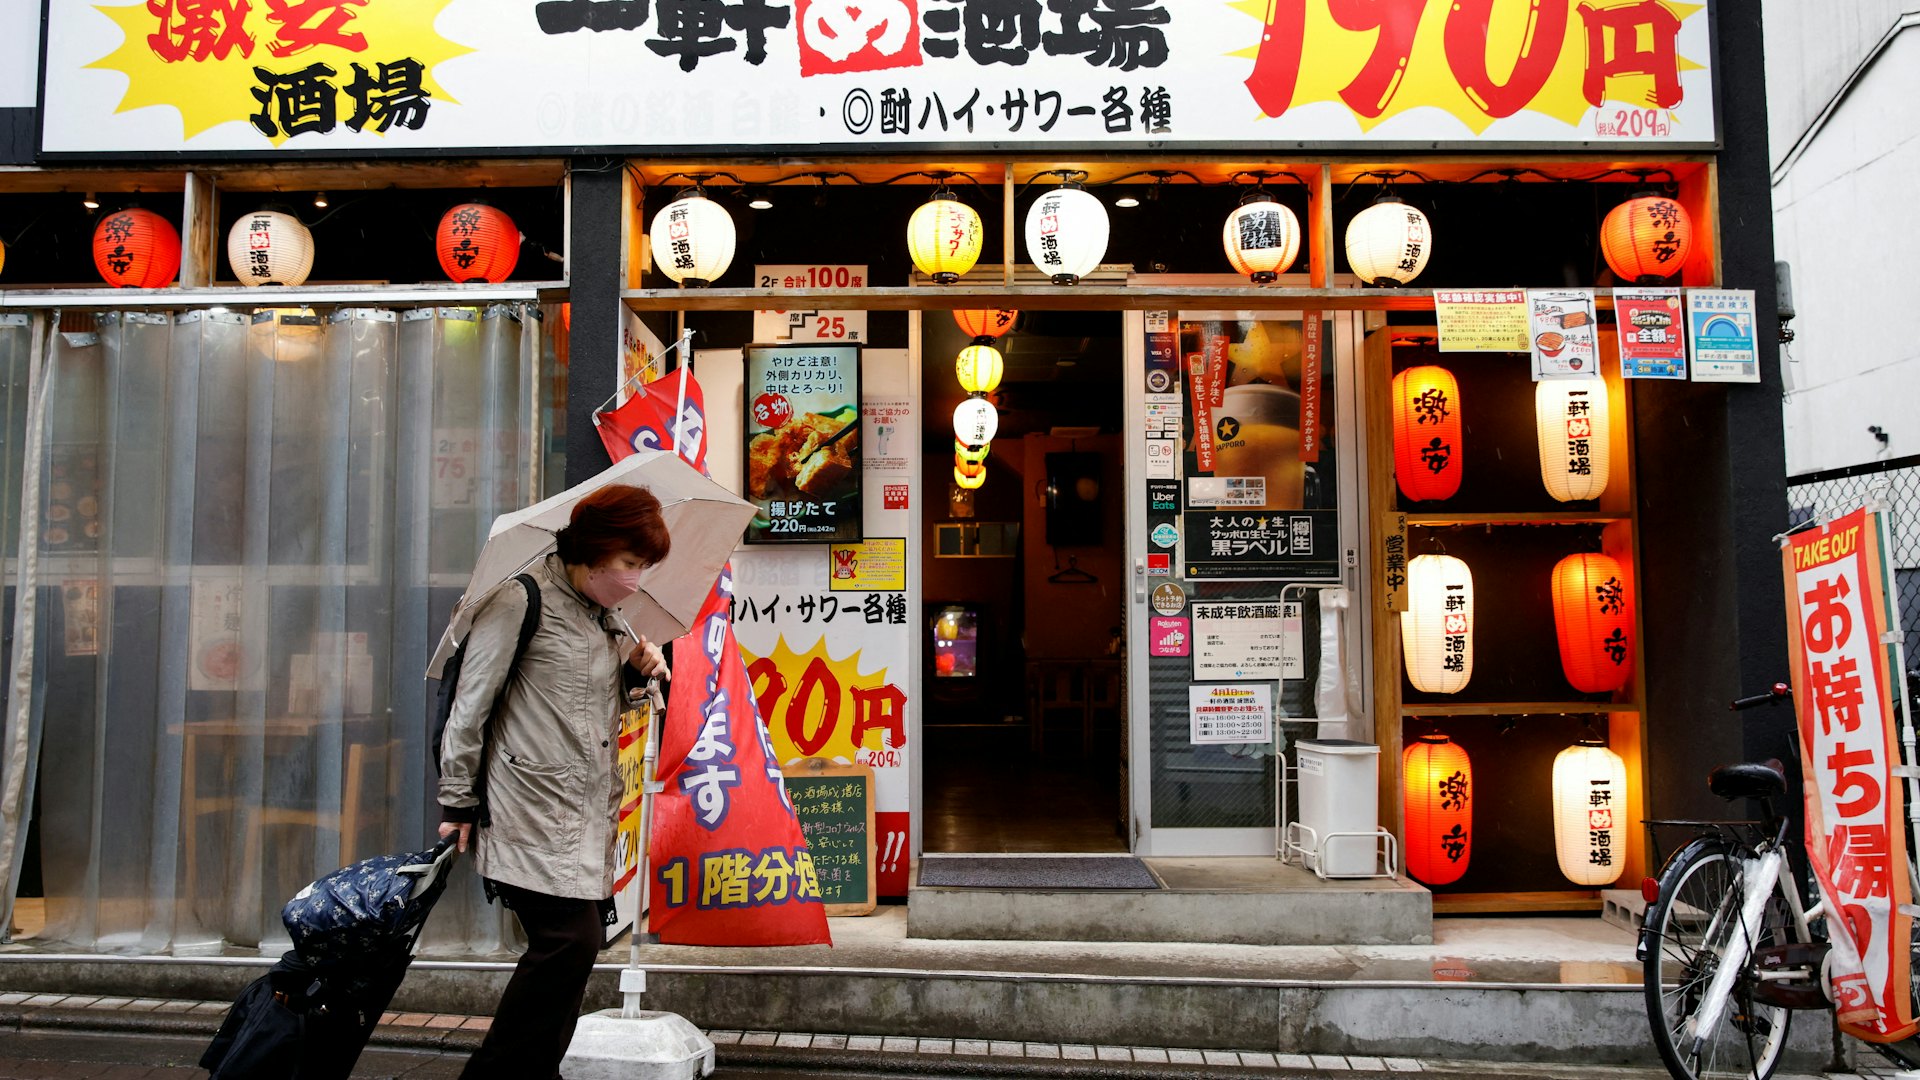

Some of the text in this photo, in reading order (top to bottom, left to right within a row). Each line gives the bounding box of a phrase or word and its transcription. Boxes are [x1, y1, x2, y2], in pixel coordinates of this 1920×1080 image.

[250, 57, 431, 138] 酒場
[105, 213, 135, 276] 激安
[250, 214, 272, 278] 一軒め酒場
[452, 207, 481, 269] 激安
[668, 203, 695, 270] 一軒め酒場
[1648, 201, 1680, 264] 激安
[766, 370, 843, 381] 外側カリカリ、
[772, 357, 837, 367] やけど注意!
[756, 399, 790, 422] 名物
[1413, 388, 1450, 475] 激安
[1567, 390, 1592, 476] 一軒め酒場
[1216, 439, 1245, 452] SAPPORO
[770, 501, 836, 517] 揚げたて
[1152, 492, 1175, 501] Uber
[1152, 502, 1175, 510] Eats
[770, 519, 806, 532] 220円
[1210, 529, 1288, 540] サッポロ生ビール
[1210, 539, 1289, 556] 黒ラベル
[1293, 521, 1310, 551] 樽生
[1794, 525, 1860, 570] TAKE OUT
[1385, 534, 1405, 592] 営業中
[1196, 605, 1297, 619] 未成年飲酒厳禁!
[1444, 584, 1468, 673] 一軒め酒場
[1596, 576, 1628, 666] 激安
[1439, 771, 1469, 864] 激安
[1589, 780, 1613, 867] 一軒め酒場
